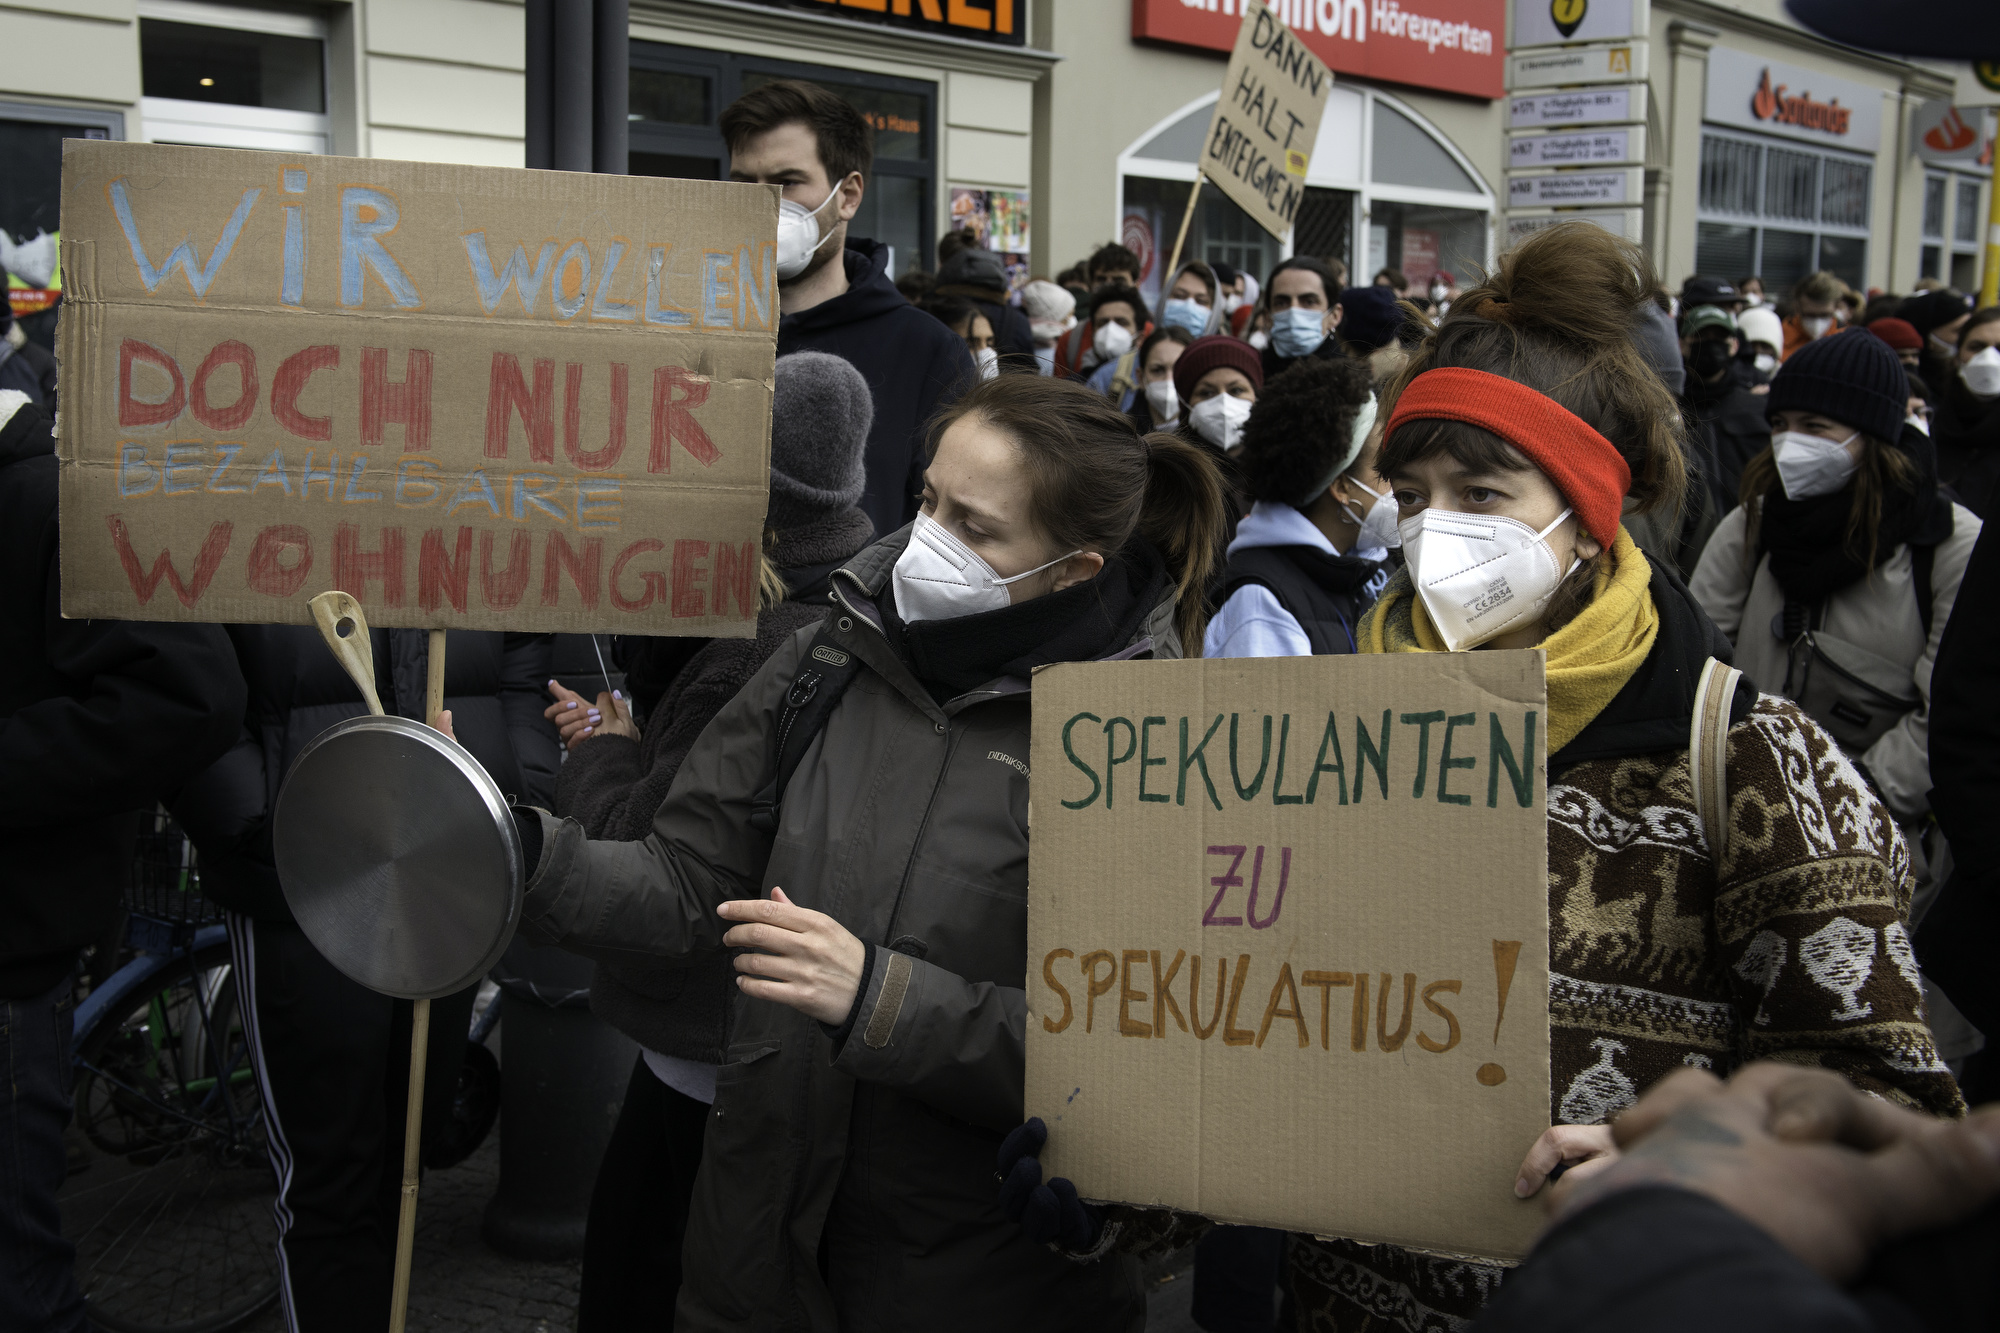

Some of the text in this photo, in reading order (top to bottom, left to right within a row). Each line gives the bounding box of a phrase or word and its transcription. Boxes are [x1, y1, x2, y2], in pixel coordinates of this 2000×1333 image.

[1251, 8, 1324, 97] DANN
[1371, 0, 1492, 54] Hörexperten
[1232, 66, 1304, 149] HALT
[1208, 117, 1301, 223] ENTEIGNEN
[461, 231, 778, 331] WOLLEN
[118, 338, 723, 474] DOCH NUR
[114, 441, 626, 532] BEZAHLBARE
[107, 514, 760, 619] WOHNUNGEN
[1487, 586, 1512, 605] 2834
[1060, 709, 1538, 811] SPEKULANTEN
[1202, 845, 1292, 929] ZU
